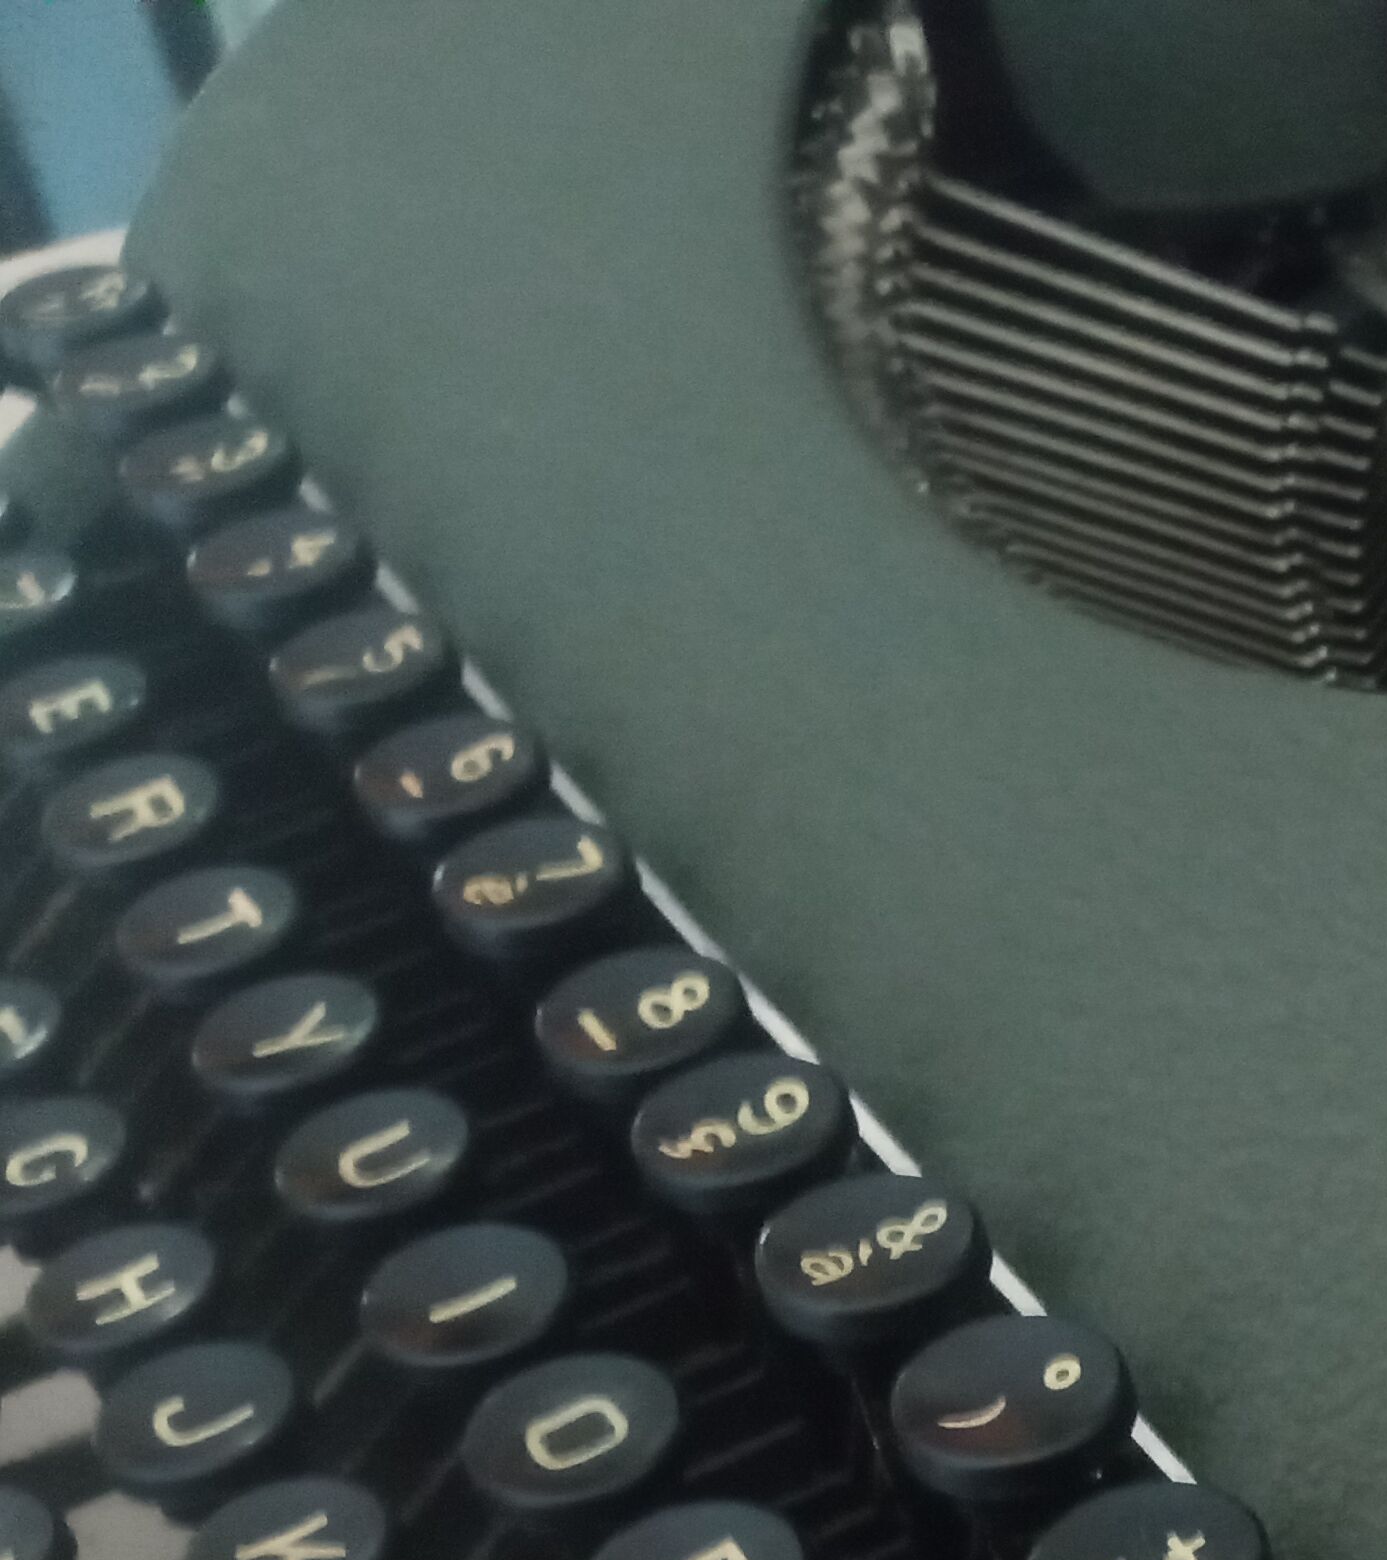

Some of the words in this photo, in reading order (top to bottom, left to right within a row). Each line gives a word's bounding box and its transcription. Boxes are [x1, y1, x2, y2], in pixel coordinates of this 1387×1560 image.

[291, 532, 334, 566] 4
[363, 625, 423, 672] 5
[29, 680, 112, 733] E
[451, 734, 514, 781] 6
[90, 775, 184, 838] R
[537, 835, 603, 880] 7
[178, 888, 262, 943] T
[638, 973, 709, 1028] 8
[253, 1002, 352, 1057] Y
[738, 1078, 809, 1134] 9
[6, 1134, 88, 1186] G
[339, 1120, 434, 1186] U
[876, 1202, 947, 1259] &
[77, 1255, 178, 1324] H
[430, 1276, 517, 1323] I
[153, 1397, 253, 1446] J
[526, 1395, 628, 1469] O
